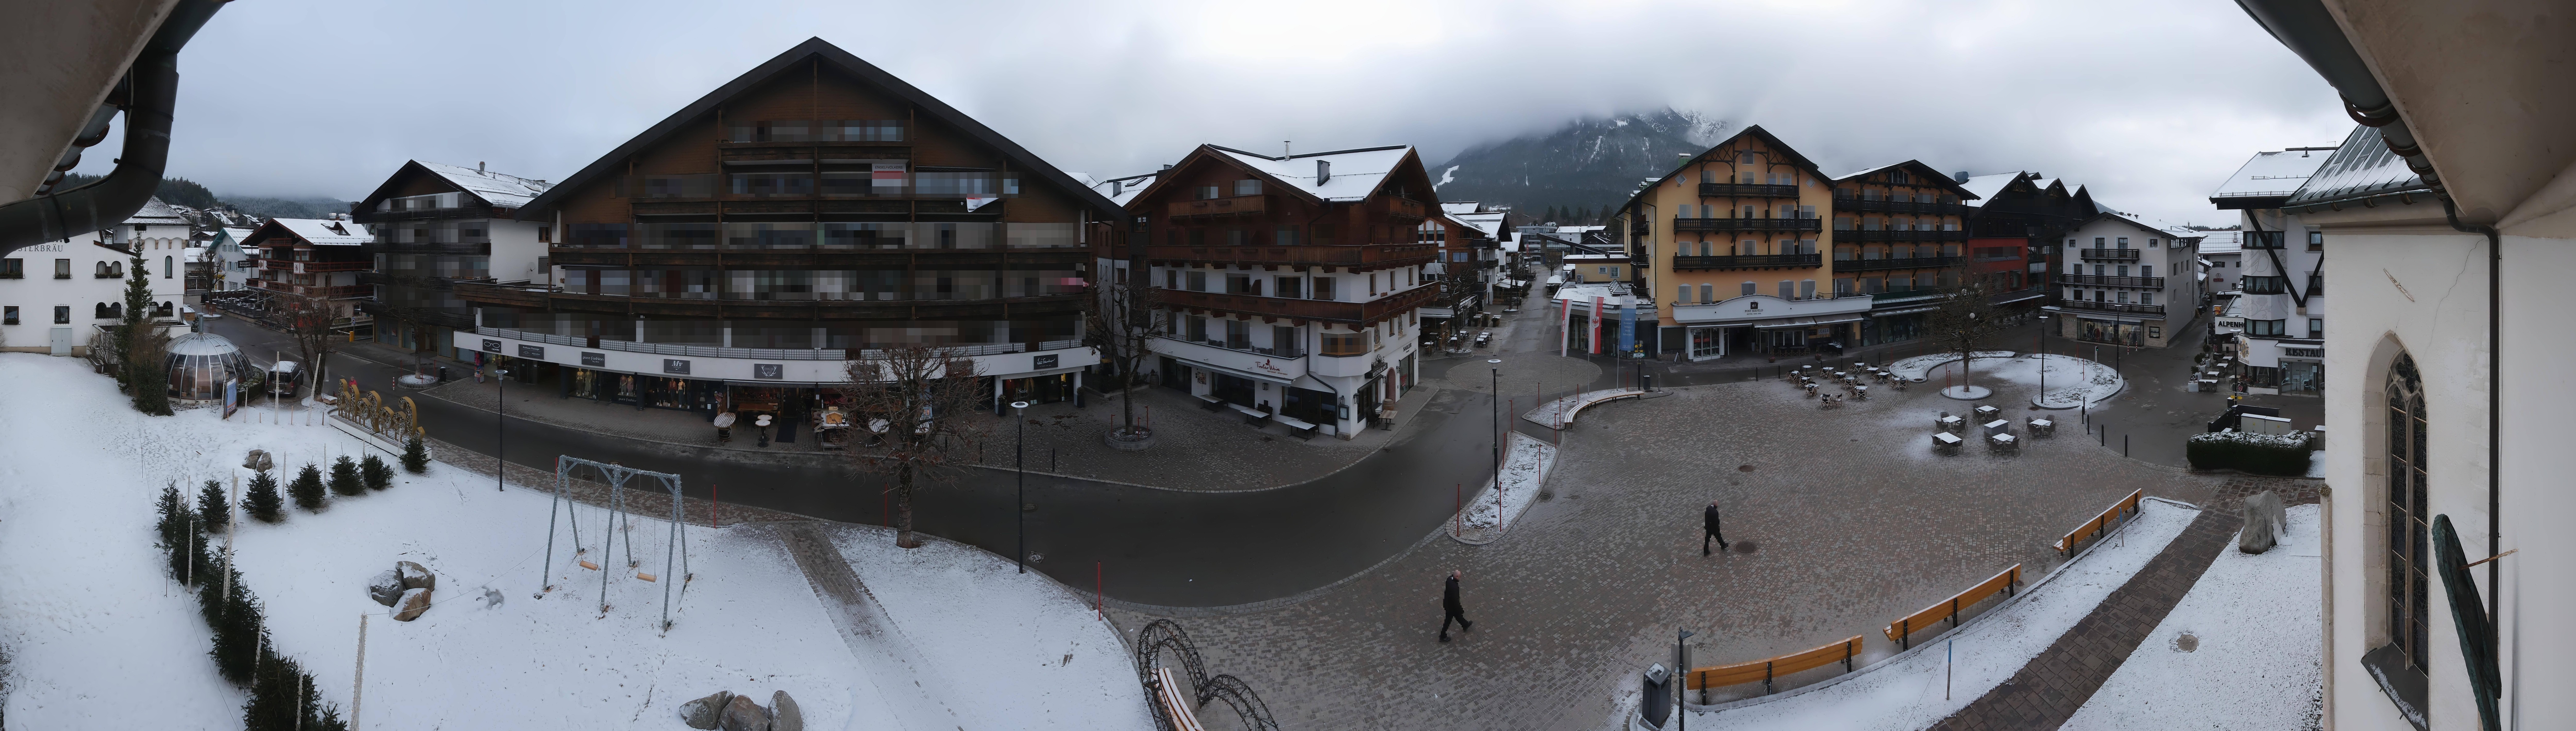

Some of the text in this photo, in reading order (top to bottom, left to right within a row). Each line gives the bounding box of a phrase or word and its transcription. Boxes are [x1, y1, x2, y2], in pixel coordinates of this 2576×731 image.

[1403, 343, 1412, 352] SAILER
[2239, 355, 2249, 364] Kaltschmid
[1373, 364, 1386, 377] RESTAURANT
